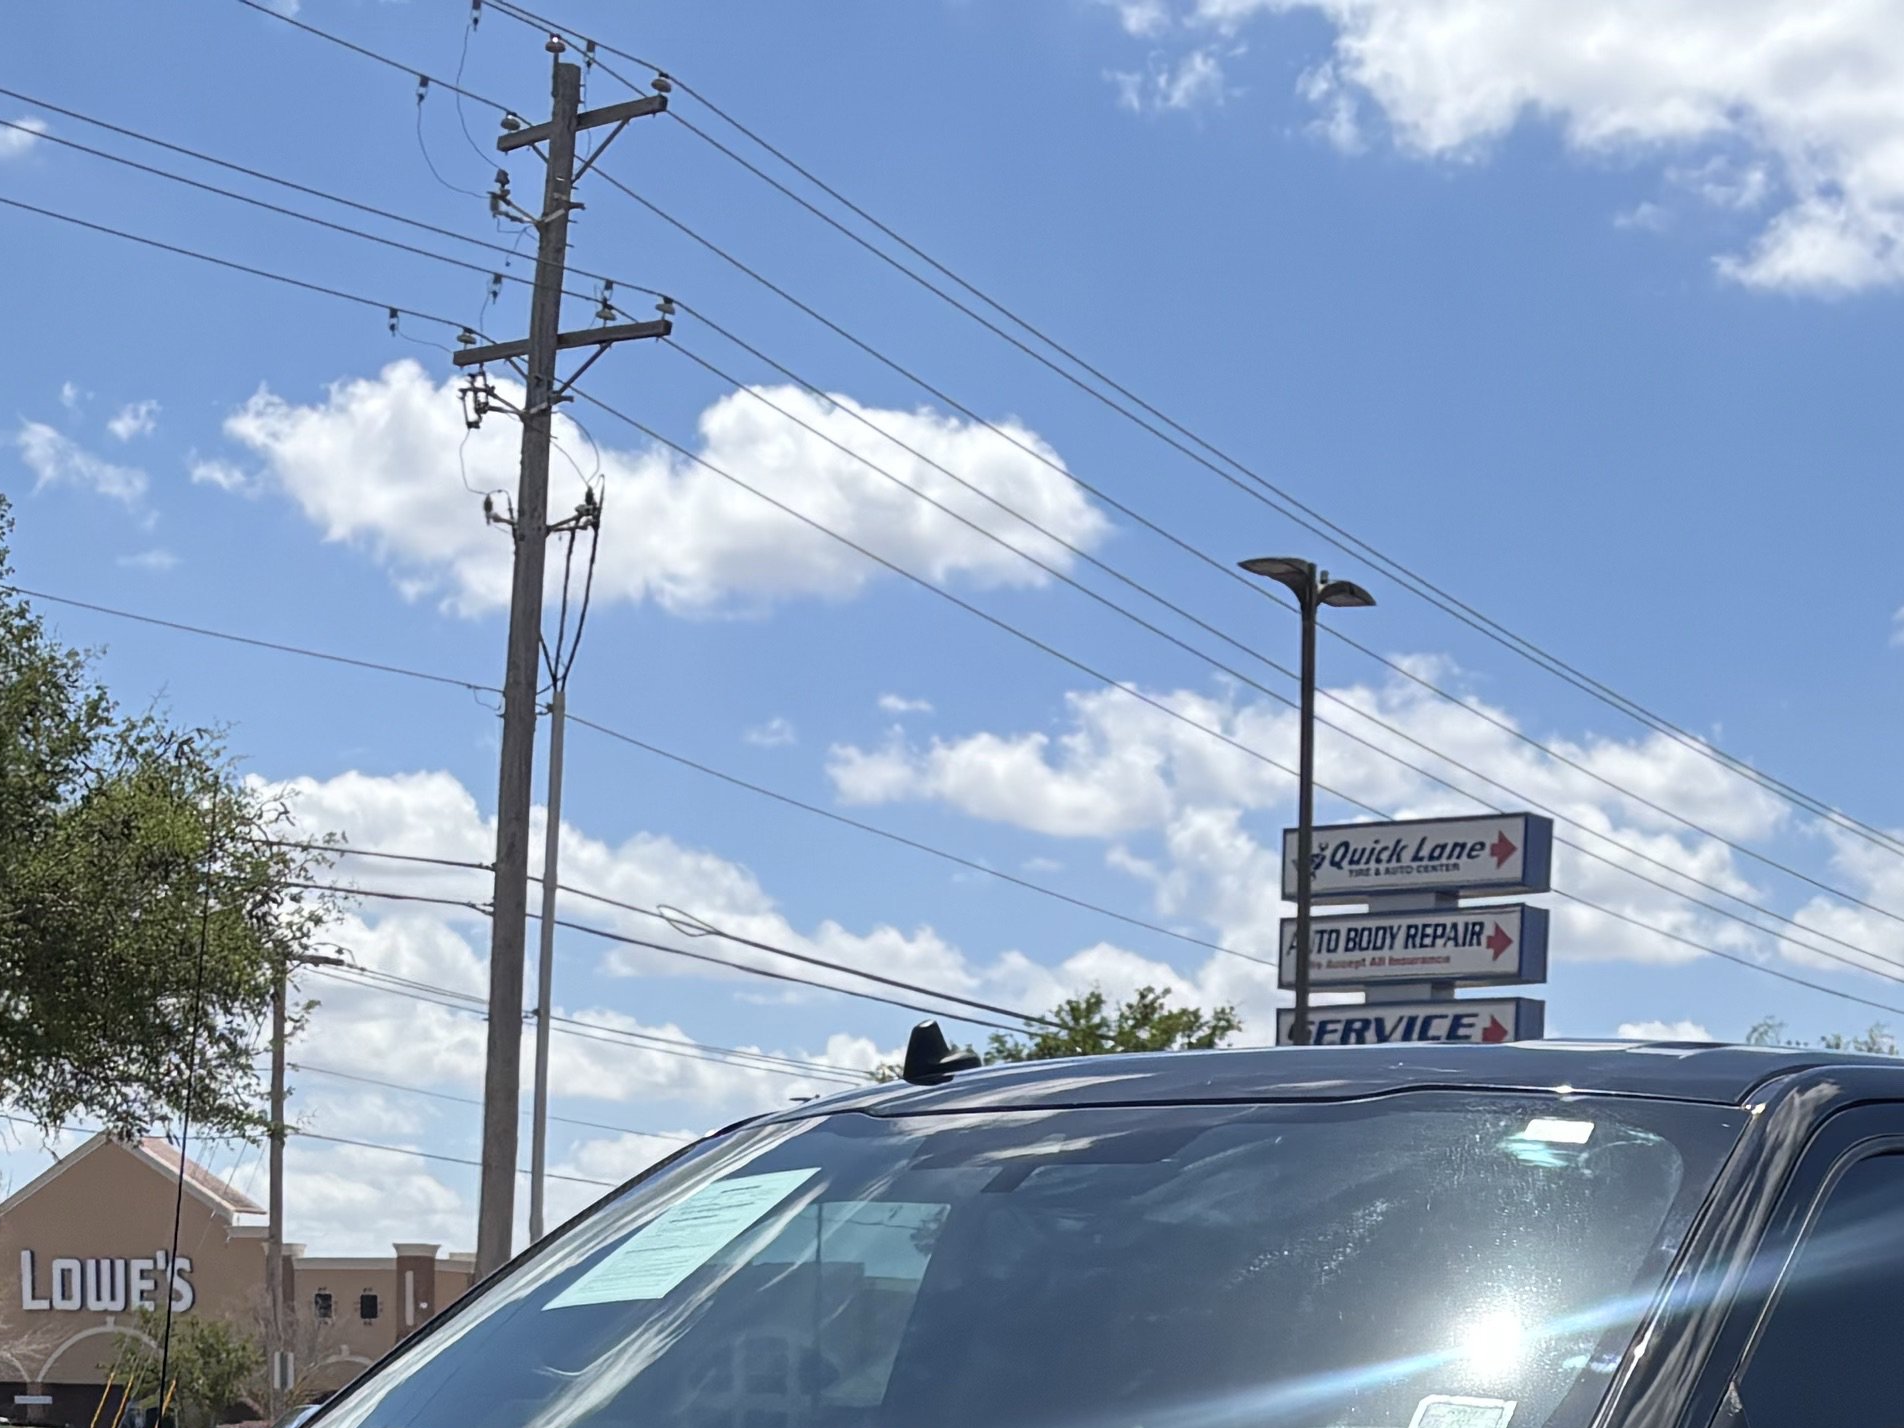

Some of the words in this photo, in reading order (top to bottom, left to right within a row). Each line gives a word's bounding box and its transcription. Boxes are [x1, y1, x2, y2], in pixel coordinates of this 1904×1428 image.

[1329, 837, 1409, 870] Quick
[1411, 836, 1487, 862] Lane
[1348, 867, 1371, 877] TIRE
[1384, 865, 1414, 875] AUTO
[1416, 862, 1460, 873] CENTER
[1344, 924, 1402, 953] BODY
[1404, 920, 1485, 949] REPAIR
[20, 1249, 194, 1313] LOWE'S
